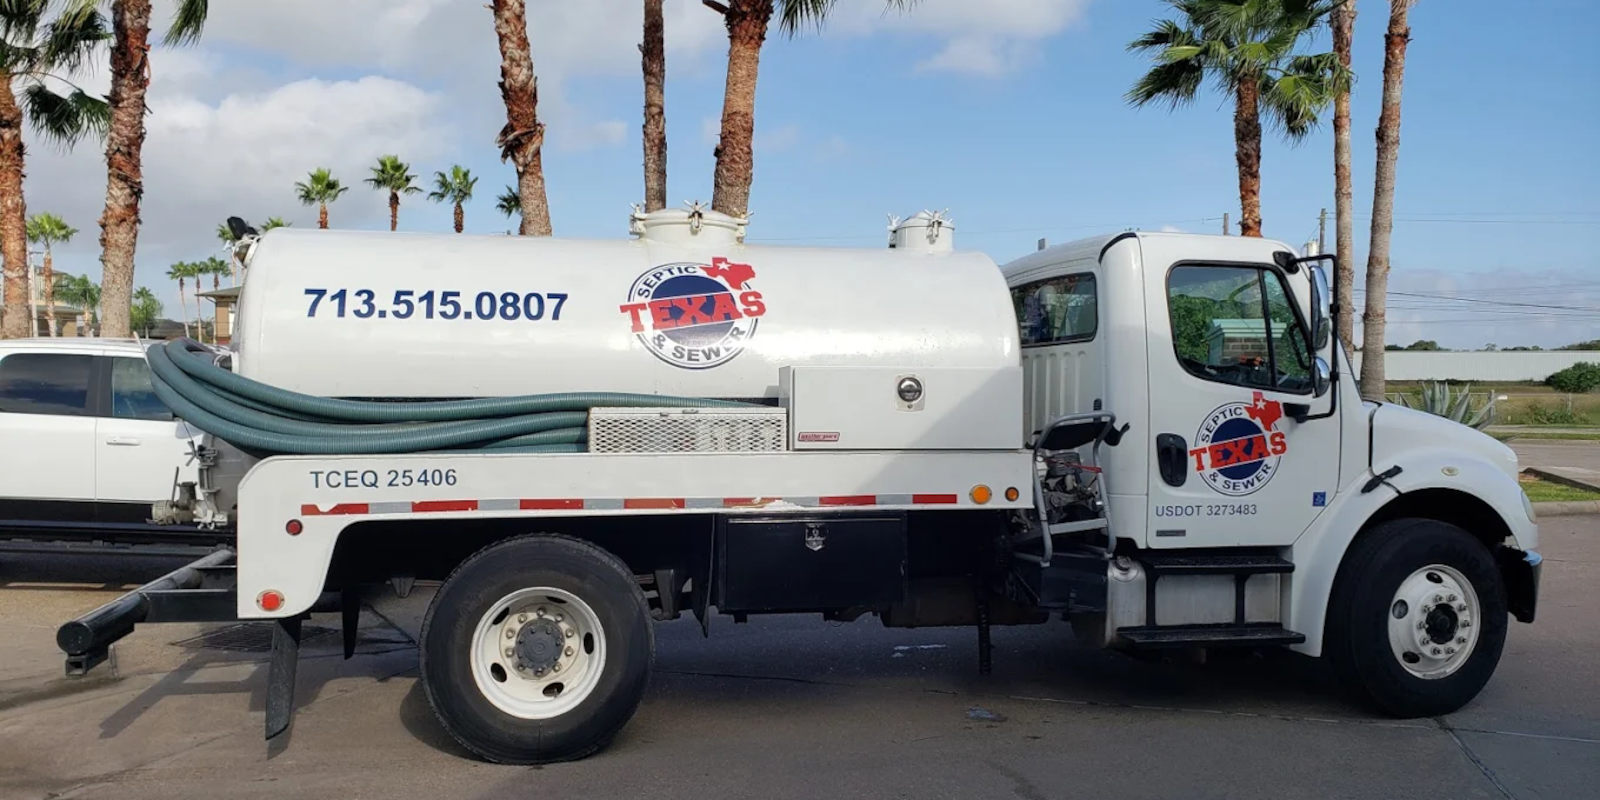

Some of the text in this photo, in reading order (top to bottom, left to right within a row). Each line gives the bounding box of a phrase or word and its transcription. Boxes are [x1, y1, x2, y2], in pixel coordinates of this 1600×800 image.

[638, 266, 698, 299] SEPTIC
[304, 288, 569, 321] 713.515.0807
[619, 290, 767, 333] TEXAS
[652, 326, 746, 362] & SEWER
[1201, 406, 1243, 443] SEPTIC
[1189, 431, 1287, 472] TEXAS
[310, 468, 457, 489] TCEQ 25406
[1208, 463, 1272, 491] & SEWER
[1155, 504, 1257, 517] USDOT 3273483
